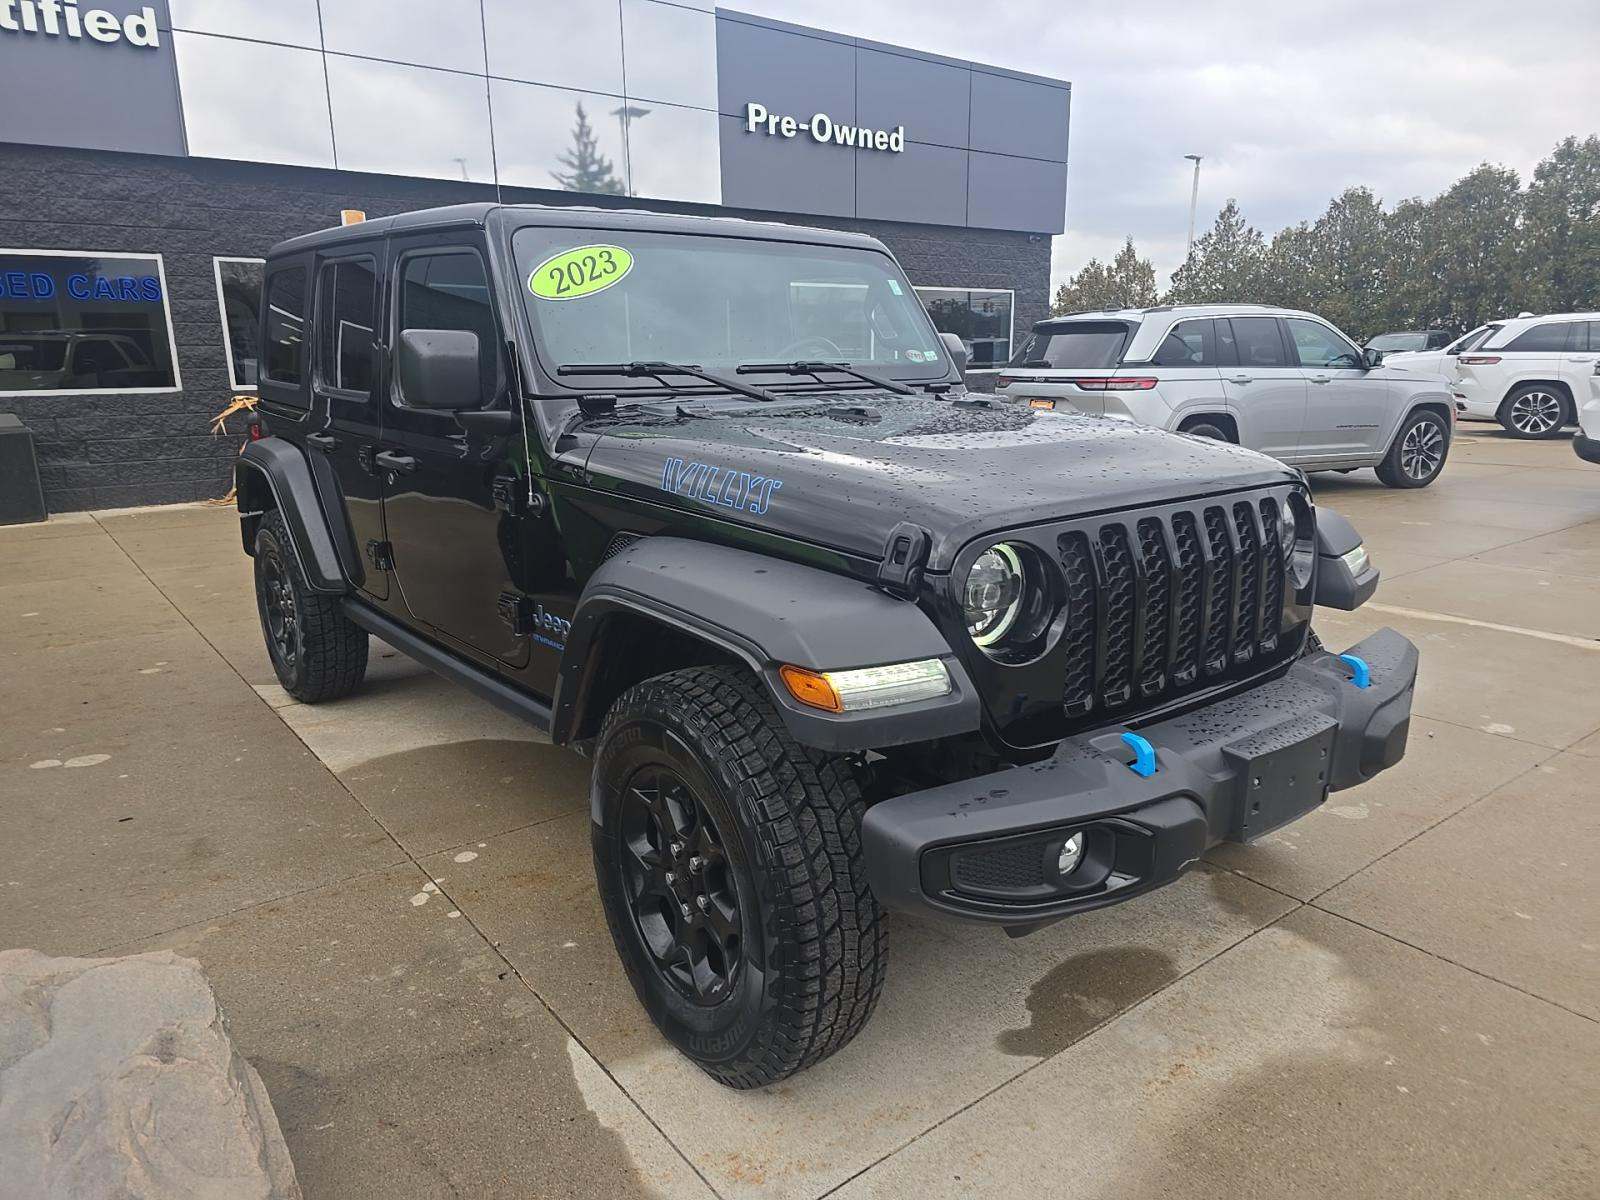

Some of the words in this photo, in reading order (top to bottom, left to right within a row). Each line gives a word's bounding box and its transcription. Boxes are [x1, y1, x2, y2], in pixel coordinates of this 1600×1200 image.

[747, 102, 904, 152] Pre-Owned
[0, 272, 55, 298] ED
[67, 273, 163, 302] CARS
[549, 250, 617, 295] 2023
[660, 457, 783, 515] WILLYS
[532, 604, 572, 640] Jeep
